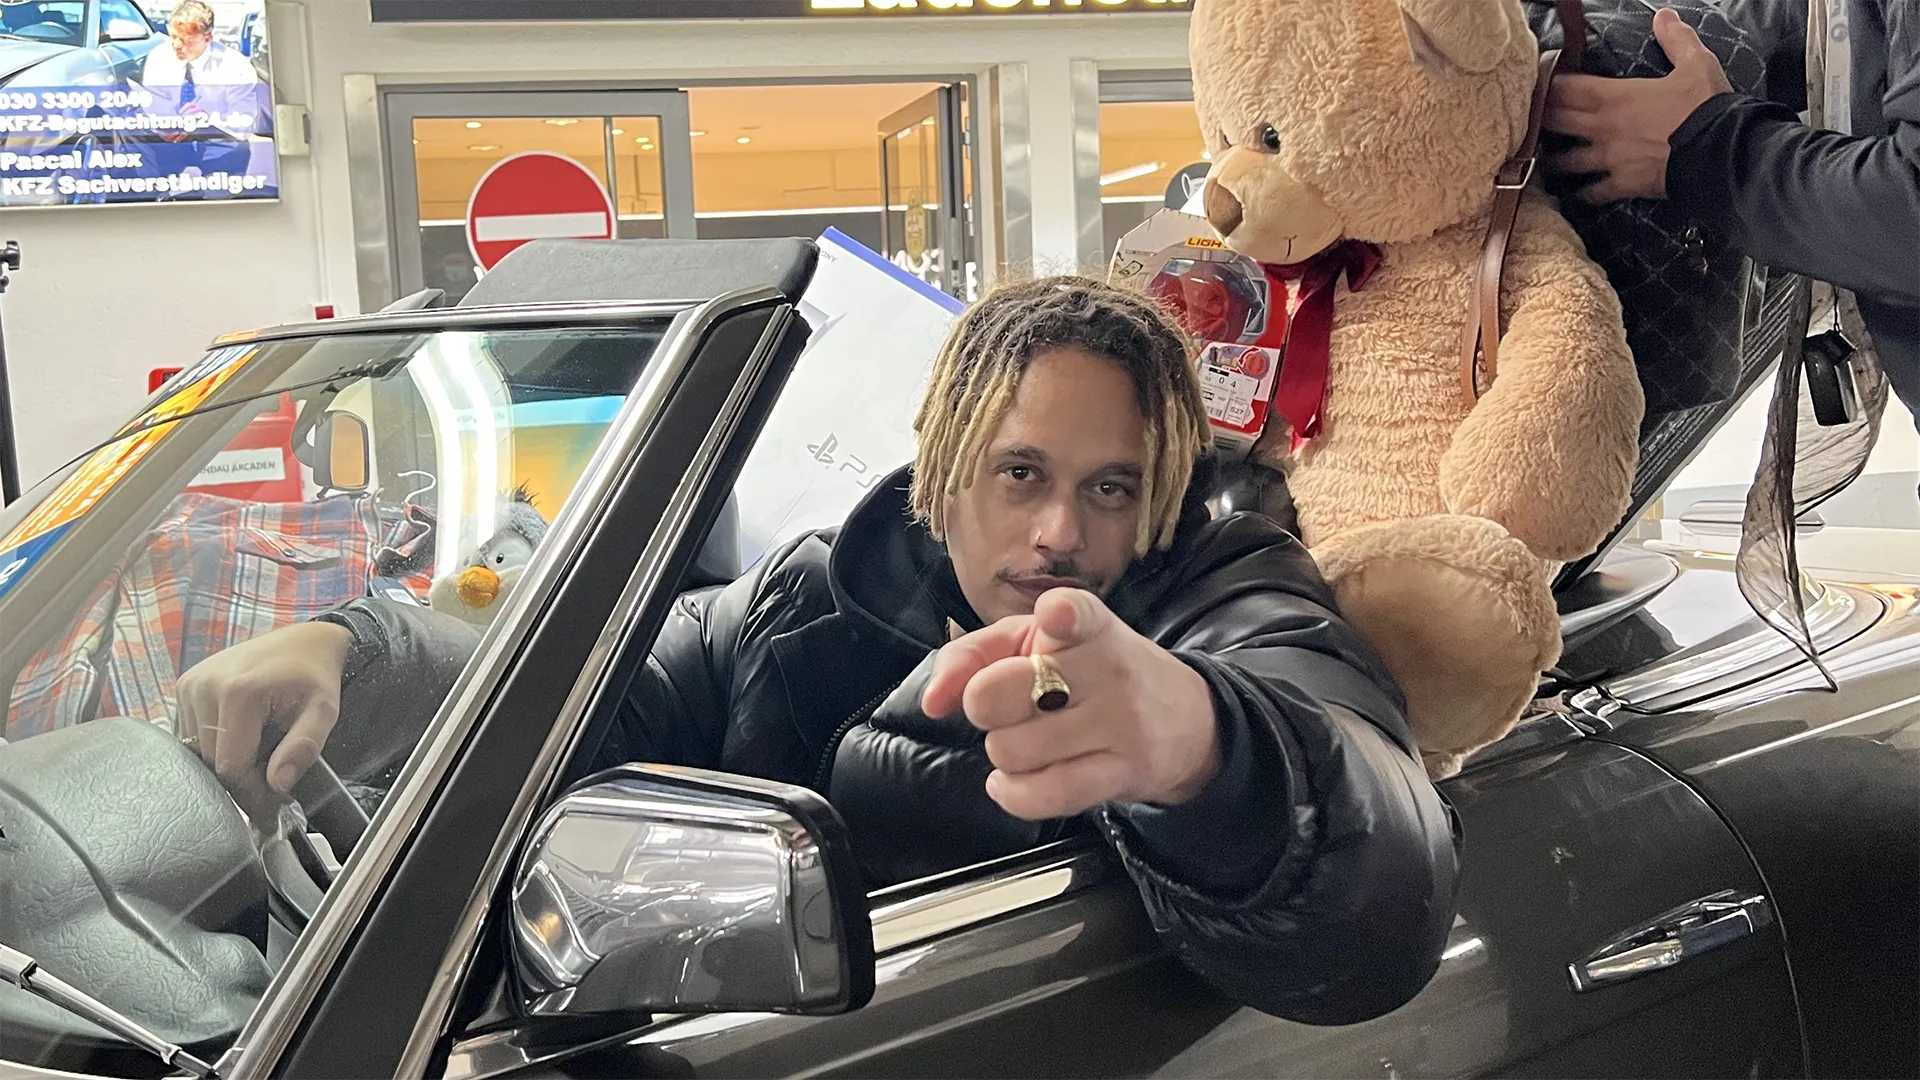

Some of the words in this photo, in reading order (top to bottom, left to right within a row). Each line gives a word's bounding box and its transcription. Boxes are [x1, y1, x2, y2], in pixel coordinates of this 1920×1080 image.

[0, 92, 37, 110] 030
[41, 91, 95, 109] 3300
[0, 150, 82, 171] Pascal
[88, 149, 143, 168] Alex
[3, 177, 54, 196] KFZ
[58, 172, 267, 195] Sachverständiger
[1187, 238, 1227, 248] LIGH
